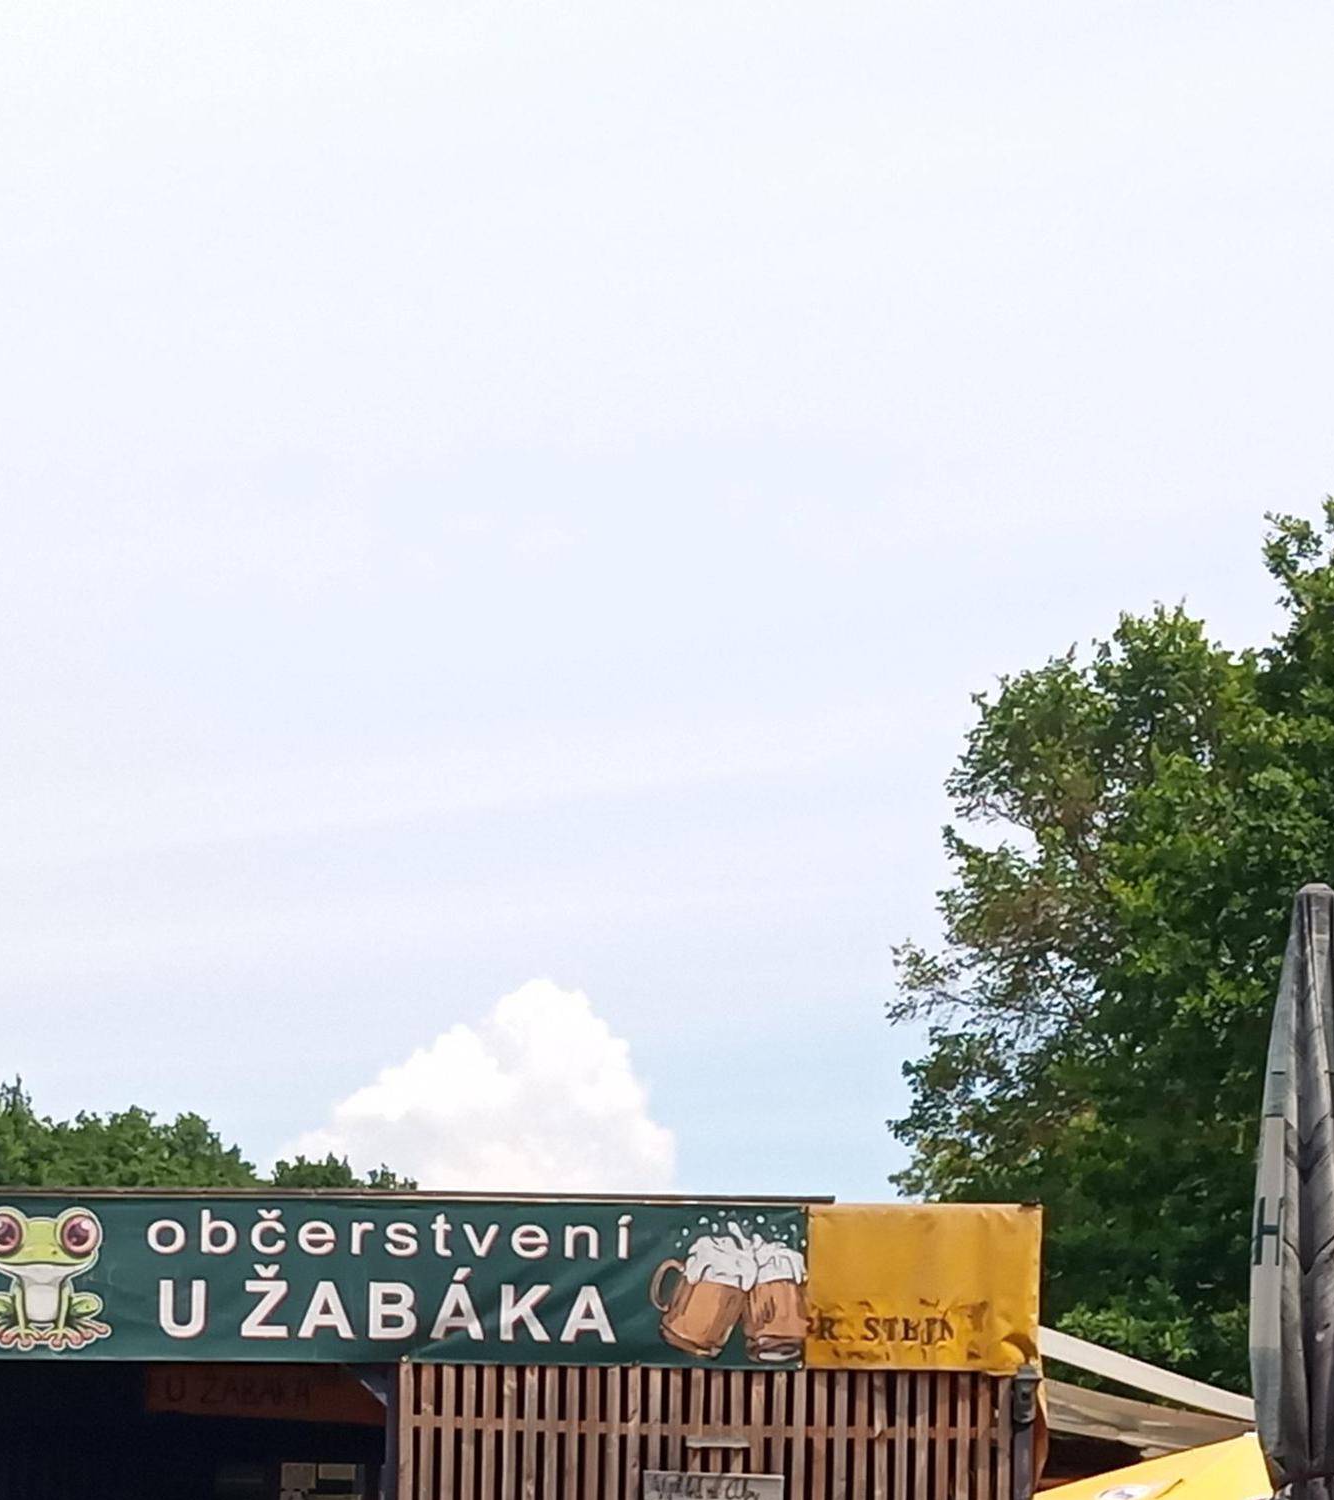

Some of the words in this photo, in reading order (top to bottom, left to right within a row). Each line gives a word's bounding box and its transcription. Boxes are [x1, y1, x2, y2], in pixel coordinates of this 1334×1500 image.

[147, 1208, 633, 1259] občerstvení
[158, 1278, 207, 1339] U
[240, 1263, 618, 1343] ŽABÁKA
